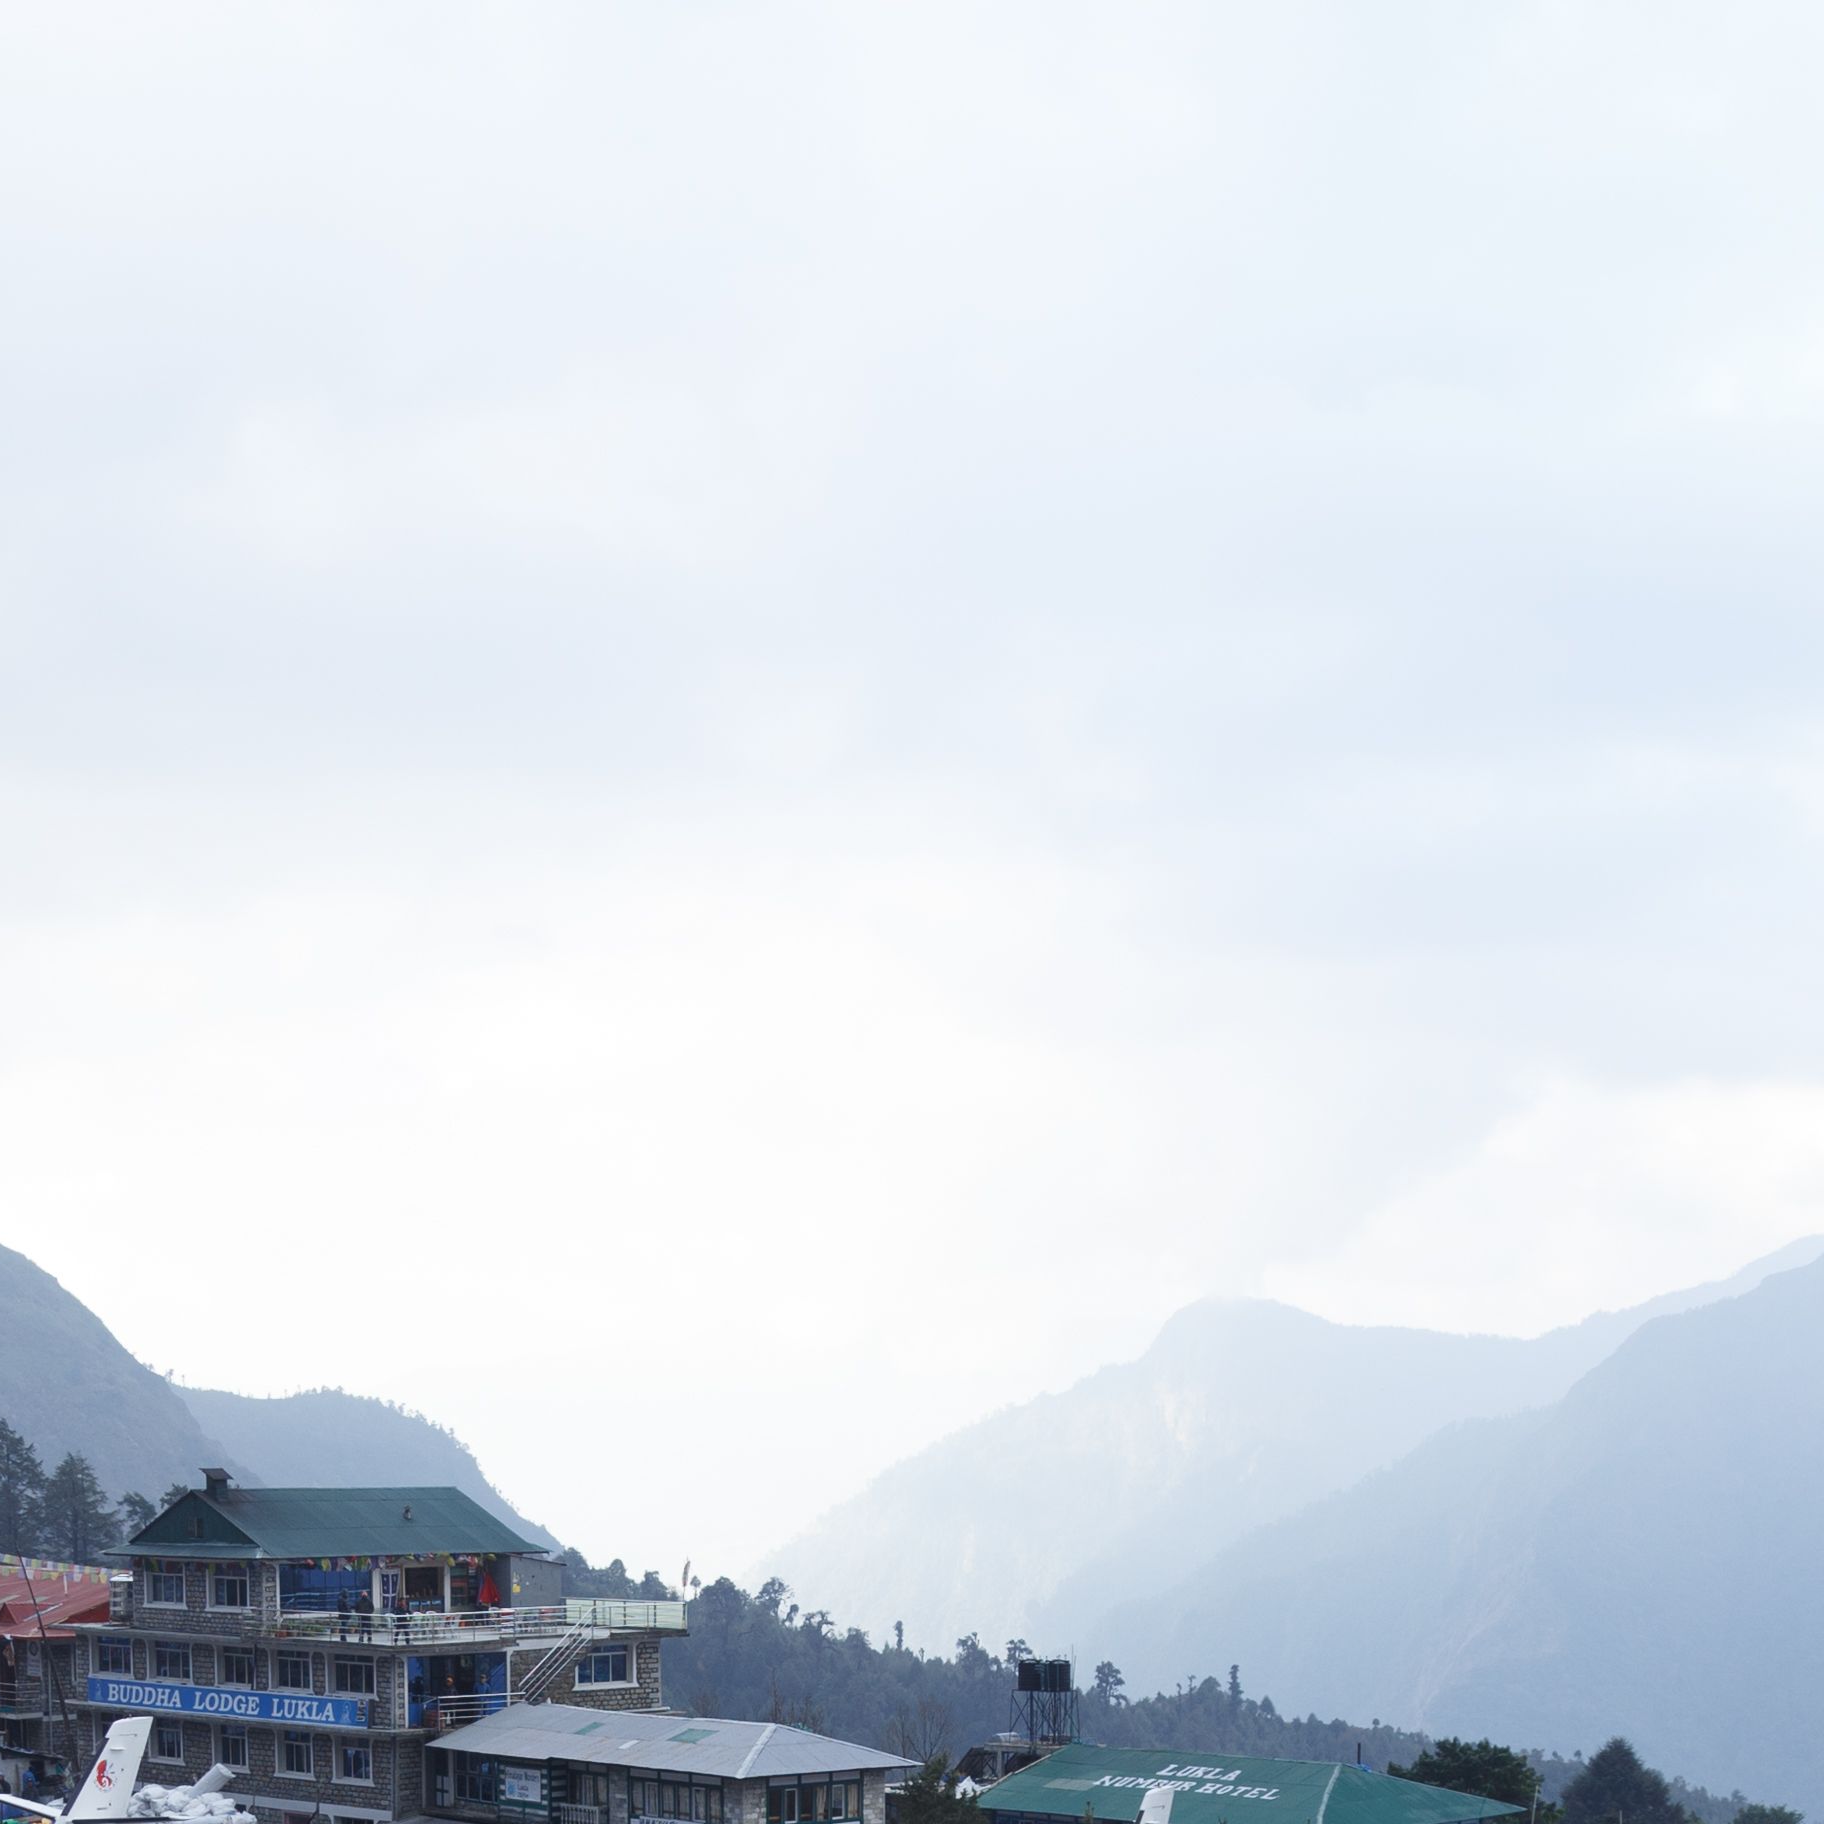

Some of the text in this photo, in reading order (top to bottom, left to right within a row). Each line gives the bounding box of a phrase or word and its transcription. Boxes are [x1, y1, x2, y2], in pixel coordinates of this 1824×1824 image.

[107, 1683, 181, 1709] BUDDHA
[193, 1691, 260, 1716] LODGE
[271, 1698, 335, 1722] LUKLA
[1156, 1764, 1242, 1781] LUKLA
[1195, 1783, 1281, 1800] HOTEL
